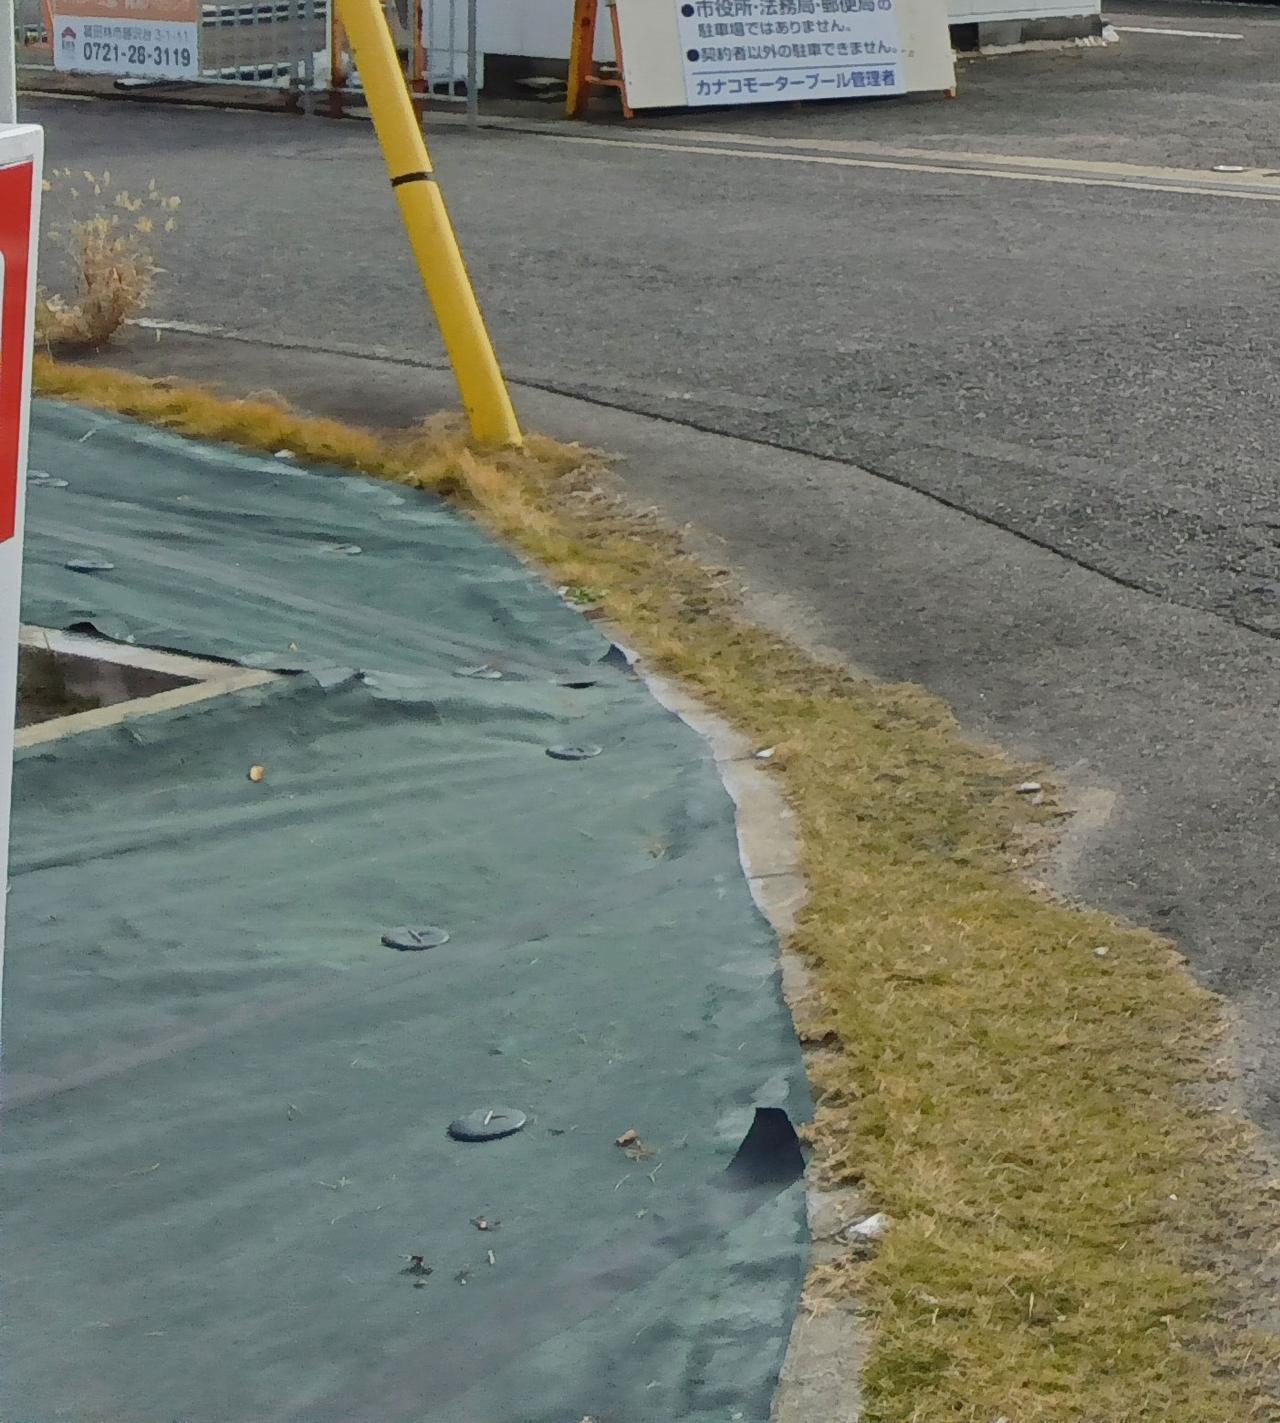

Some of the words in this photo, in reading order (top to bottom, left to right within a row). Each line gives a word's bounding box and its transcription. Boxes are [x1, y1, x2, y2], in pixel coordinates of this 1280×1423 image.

[697, 19, 852, 39] 駐車場ではありません。
[83, 42, 191, 67] 0721-28-3119
[701, 39, 898, 63] 契約者以外の駐車できません。
